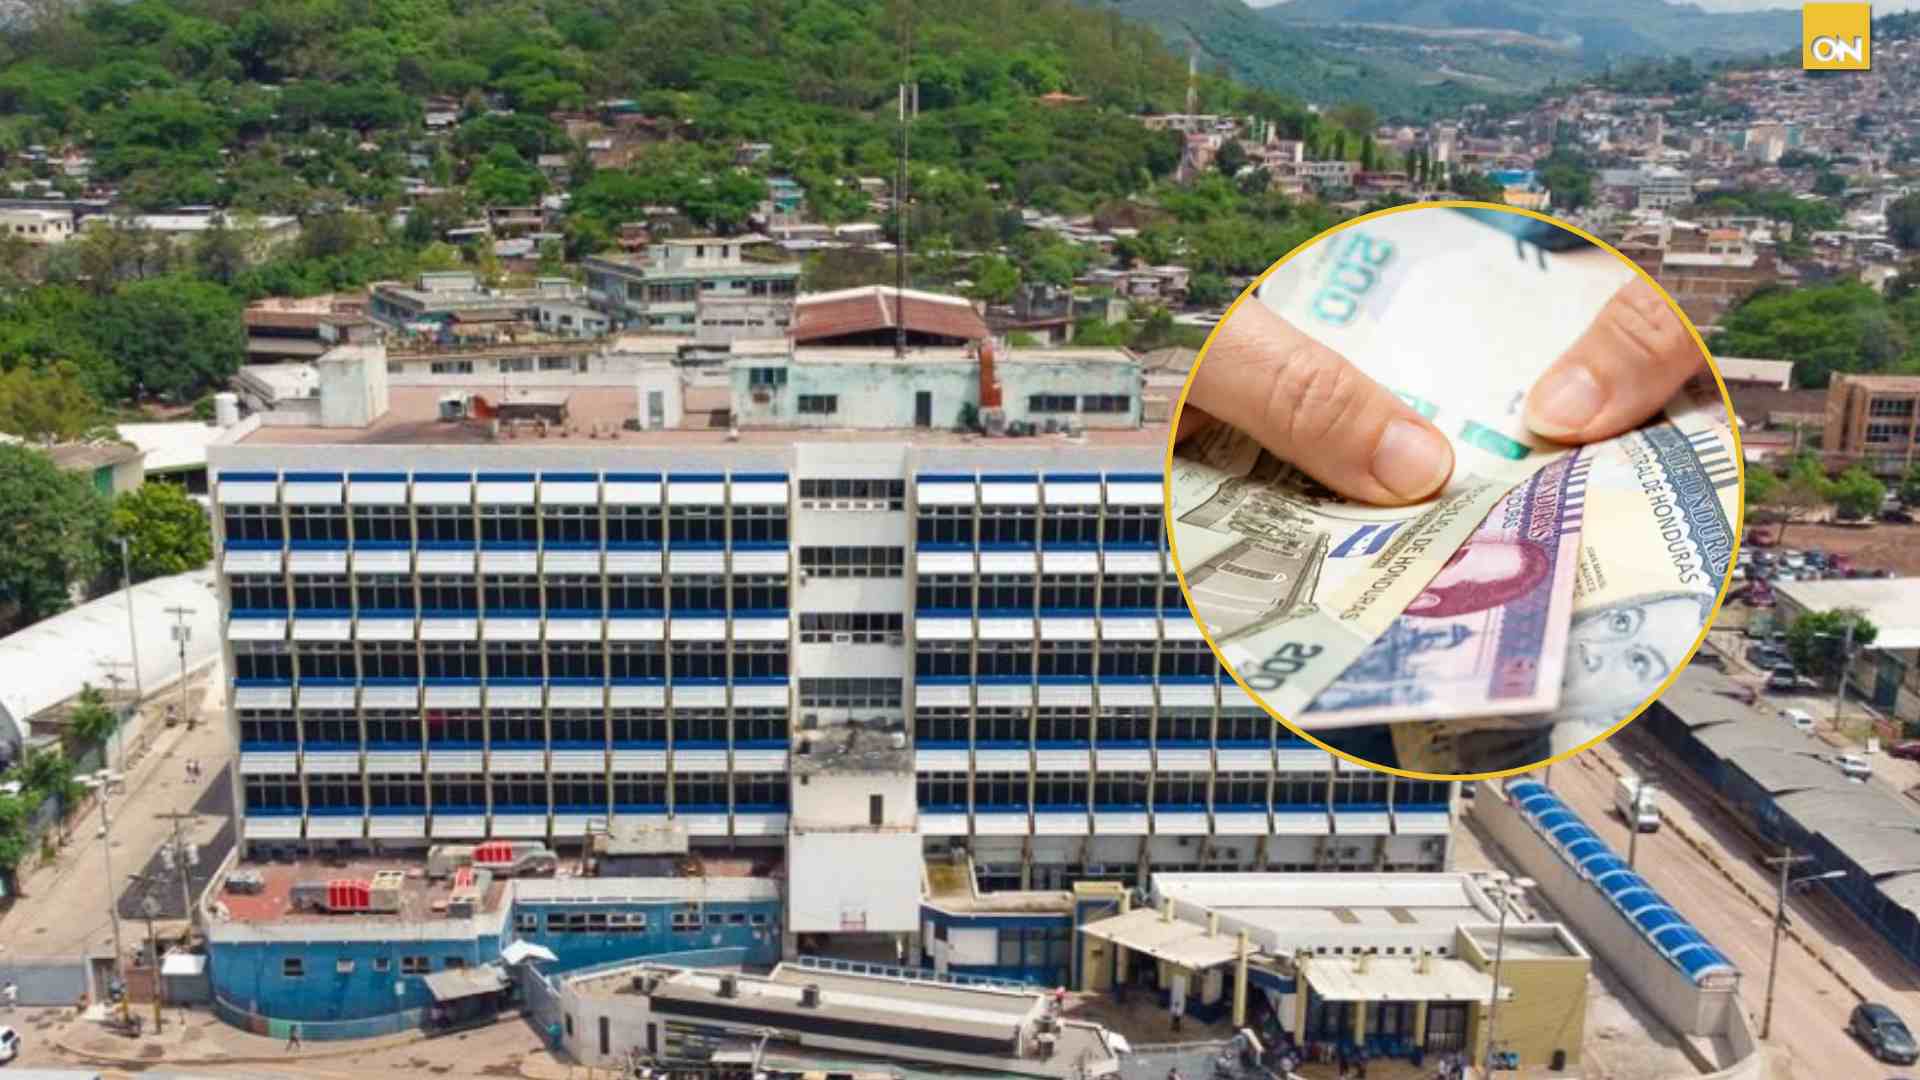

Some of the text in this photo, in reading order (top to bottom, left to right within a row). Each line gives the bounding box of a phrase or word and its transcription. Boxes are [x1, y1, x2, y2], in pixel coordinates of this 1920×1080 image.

[1313, 232, 1393, 323] 200
[1641, 479, 1663, 495] DE
[1404, 537, 1432, 553] DE
[1650, 493, 1699, 585] HONDURAS
[1339, 556, 1416, 620] HONDURAS
[1248, 643, 1322, 691] 200
